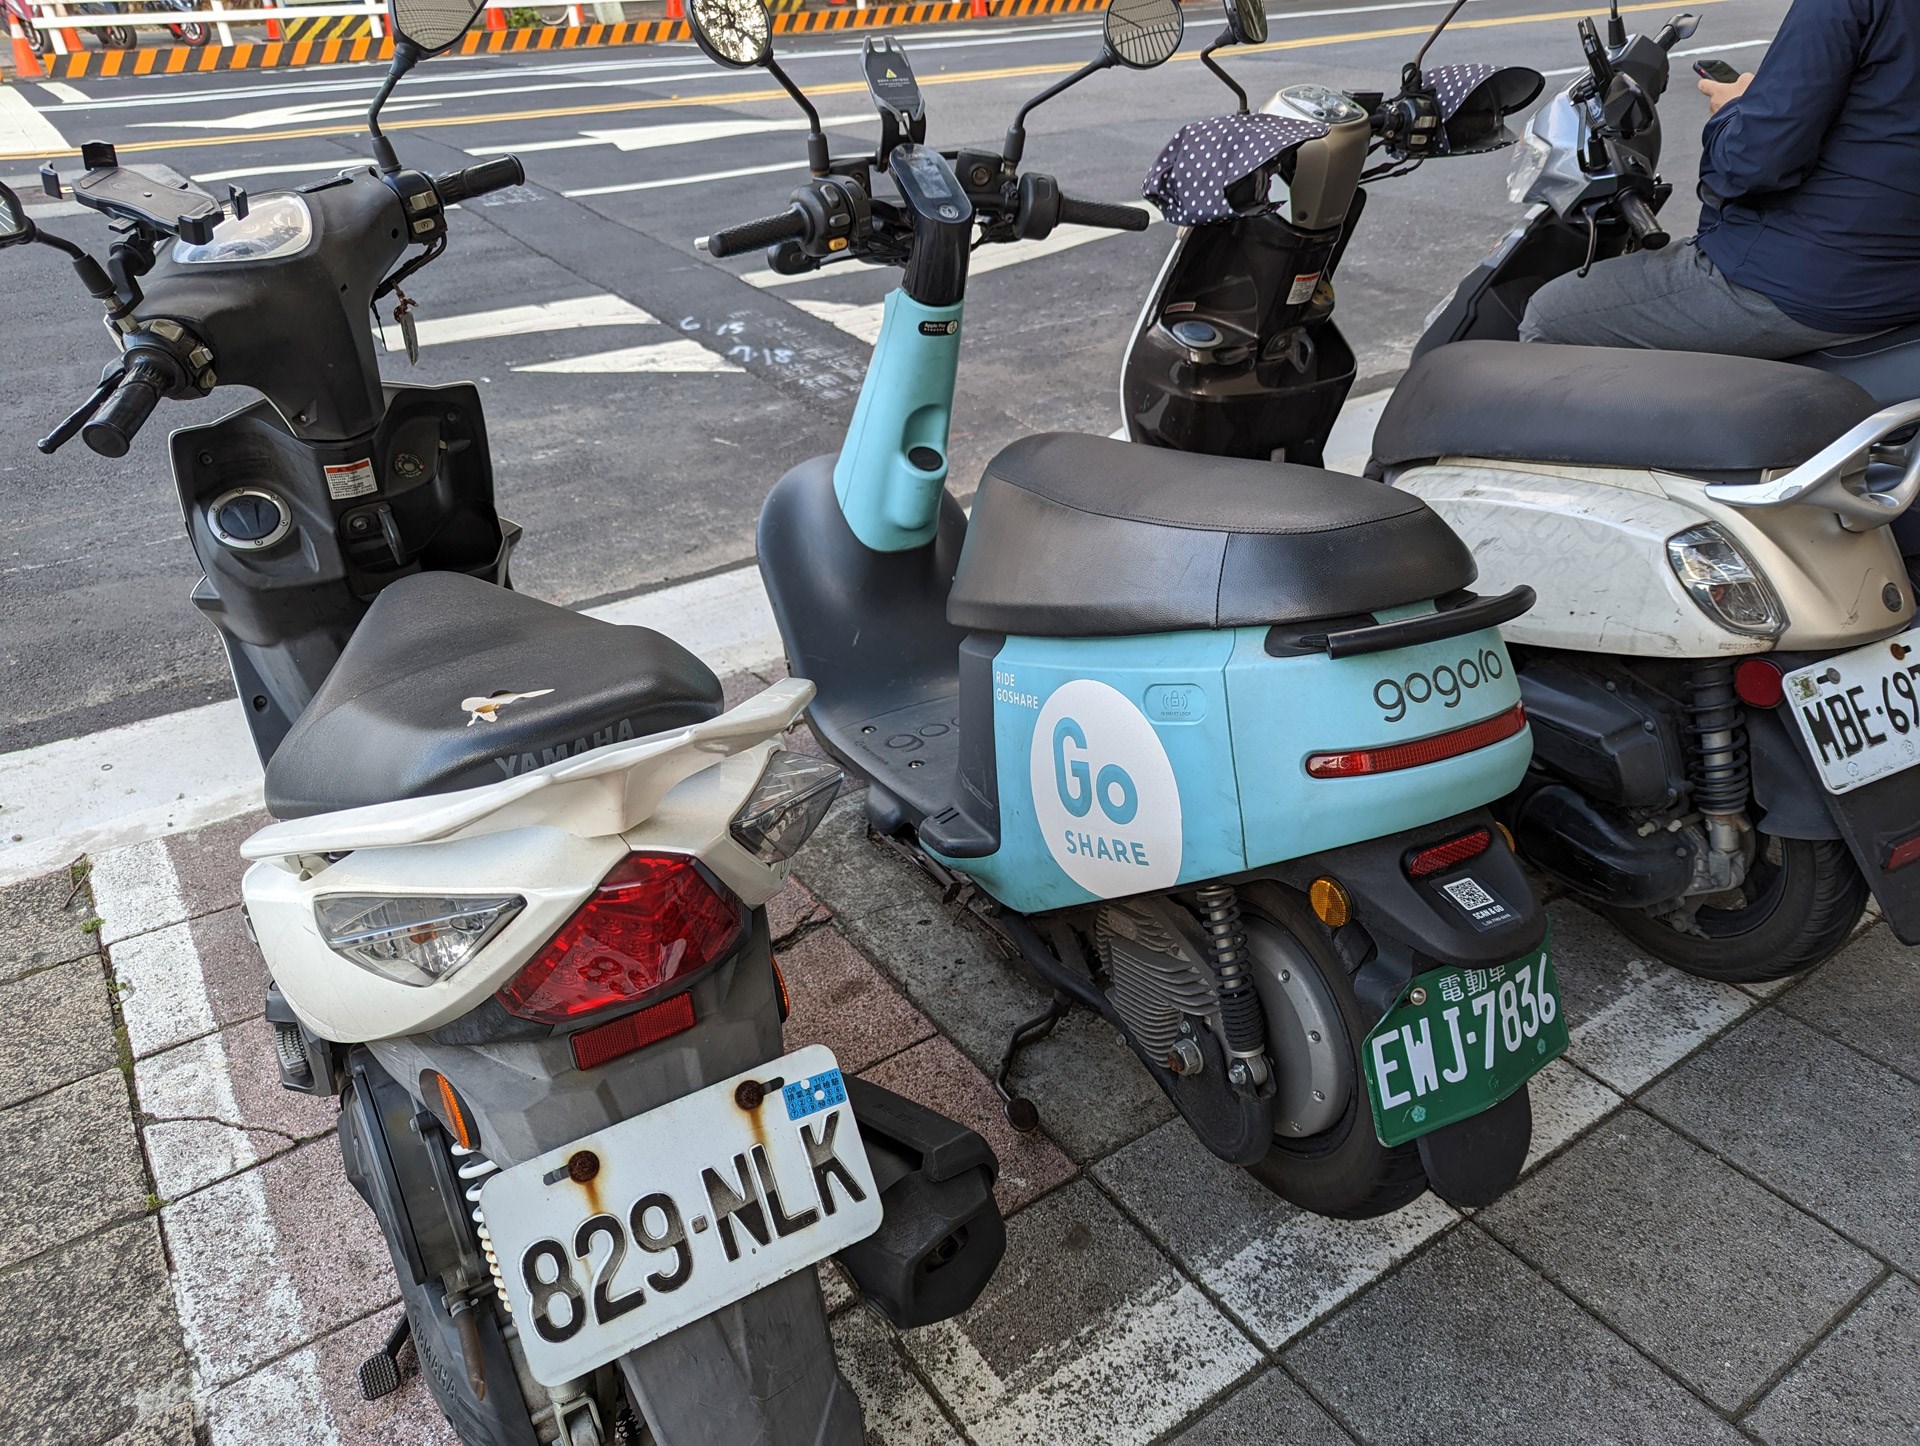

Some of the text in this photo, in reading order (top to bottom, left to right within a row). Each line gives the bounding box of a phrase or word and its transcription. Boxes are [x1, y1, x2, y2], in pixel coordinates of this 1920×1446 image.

[996, 671, 1015, 687] RIDE
[996, 687, 1039, 710] GOSHARE
[495, 718, 635, 780] YAMAHA
[1064, 829, 1150, 867] SHARE
[1472, 909, 1491, 920] SCAN
[1493, 904, 1505, 913] GO
[1438, 964, 1507, 1003] 電動車
[814, 1076, 826, 1084] 110
[829, 1071, 839, 1079] 111
[414, 1315, 457, 1399] YAMAHA
